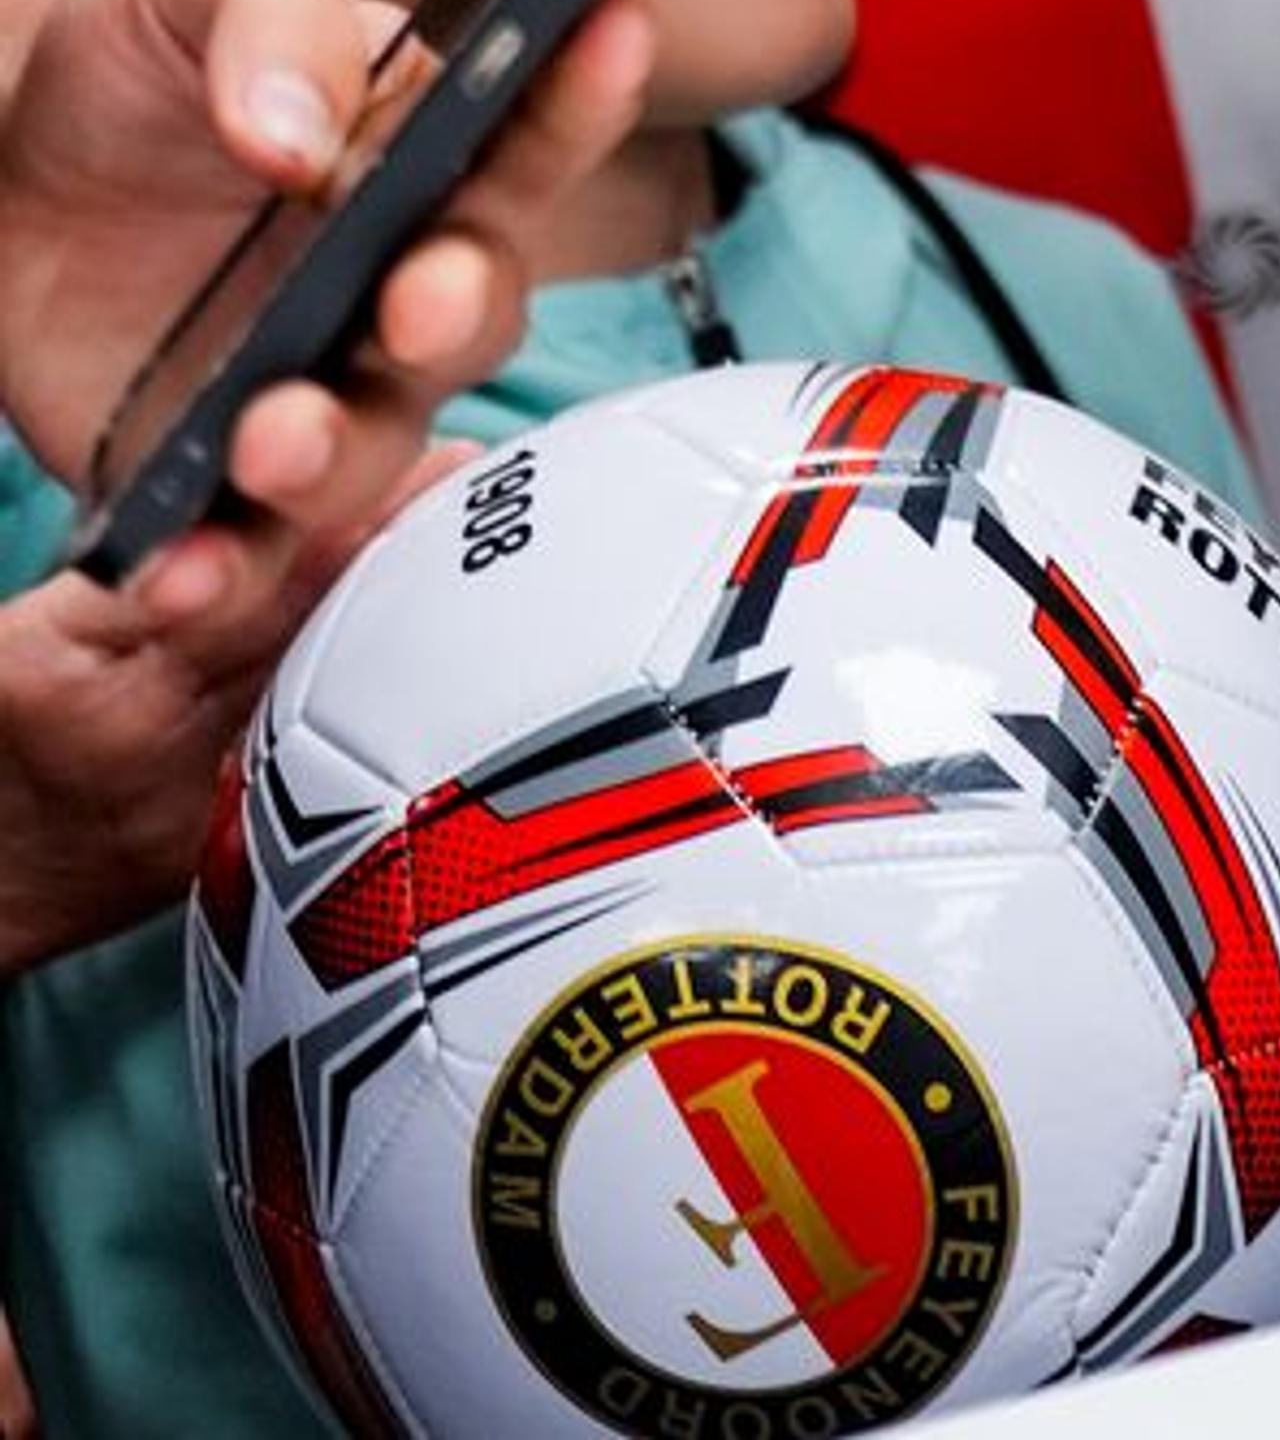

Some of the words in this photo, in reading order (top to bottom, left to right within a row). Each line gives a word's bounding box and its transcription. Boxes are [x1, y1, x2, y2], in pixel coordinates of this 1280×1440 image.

[461, 449, 536, 574] 1908
[490, 956, 891, 1231] ROTTERDAM
[598, 1182, 1000, 1440] FEYENOORD
